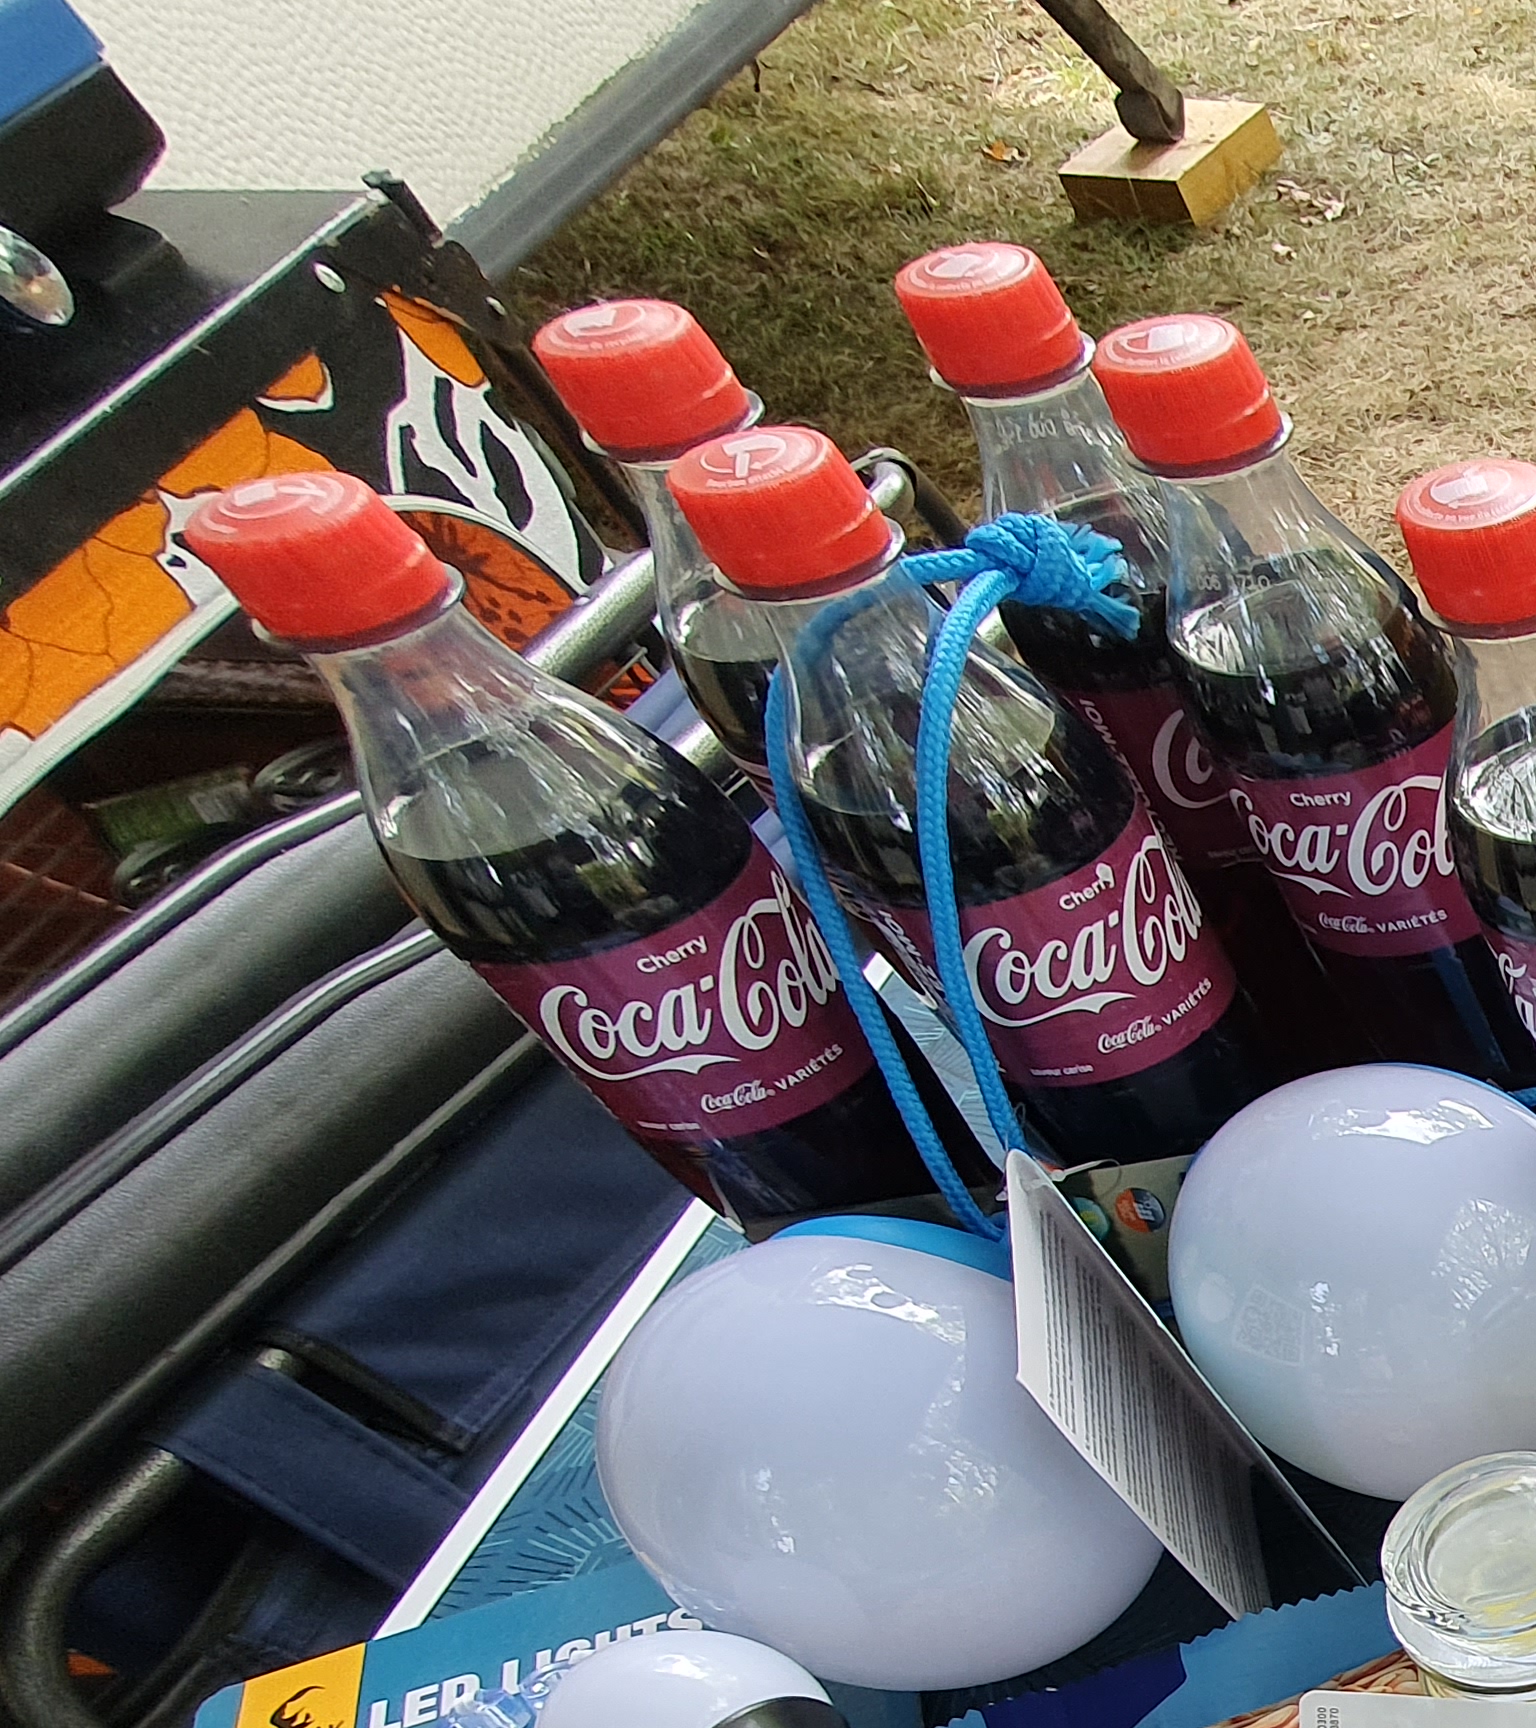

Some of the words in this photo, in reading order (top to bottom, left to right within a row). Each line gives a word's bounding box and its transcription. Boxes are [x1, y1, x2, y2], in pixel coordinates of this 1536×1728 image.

[1290, 791, 1351, 808] Cherry
[1230, 768, 1455, 898] Coca-Col
[1059, 862, 1115, 910] Cherr
[1376, 909, 1448, 933] VARIÉTÉS
[541, 868, 842, 1081] Coca-Cola
[636, 934, 709, 974] Cherry
[1098, 1016, 1155, 1054] Coca-Cola
[1161, 978, 1212, 1026] VARIÉTÉS
[701, 1080, 767, 1113] Coca-Cola
[774, 1042, 844, 1091] VARIÉTÉS
